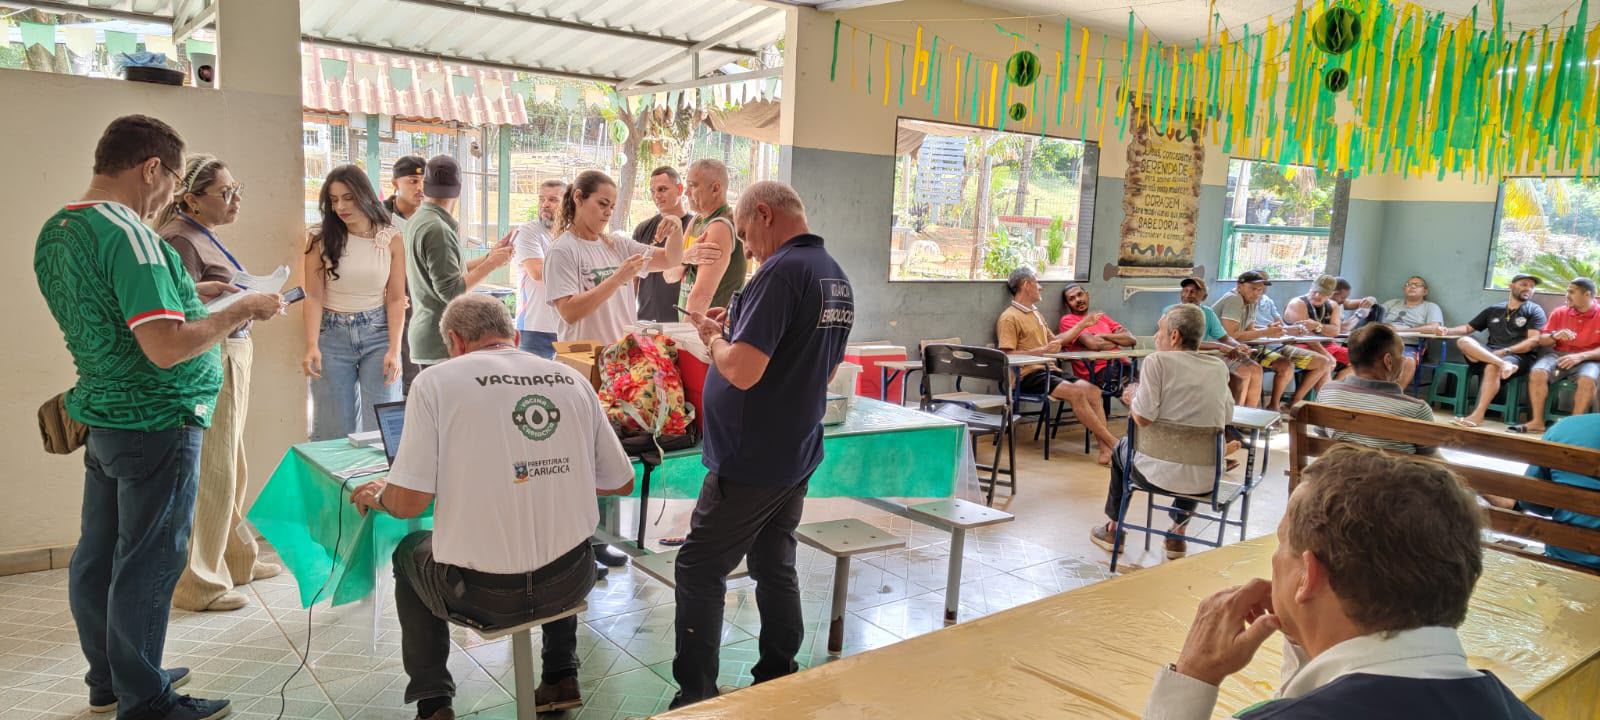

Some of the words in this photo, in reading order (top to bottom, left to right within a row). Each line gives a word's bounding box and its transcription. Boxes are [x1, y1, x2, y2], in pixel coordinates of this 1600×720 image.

[1140, 158, 1188, 176] SERENIDADE
[1144, 194, 1180, 210] CORAGEM
[1138, 216, 1179, 232] SABEDORIA
[475, 371, 575, 387] VACINAÇÃO
[527, 458, 562, 467] PREFEITURA
[529, 464, 571, 477] CARIACICA
